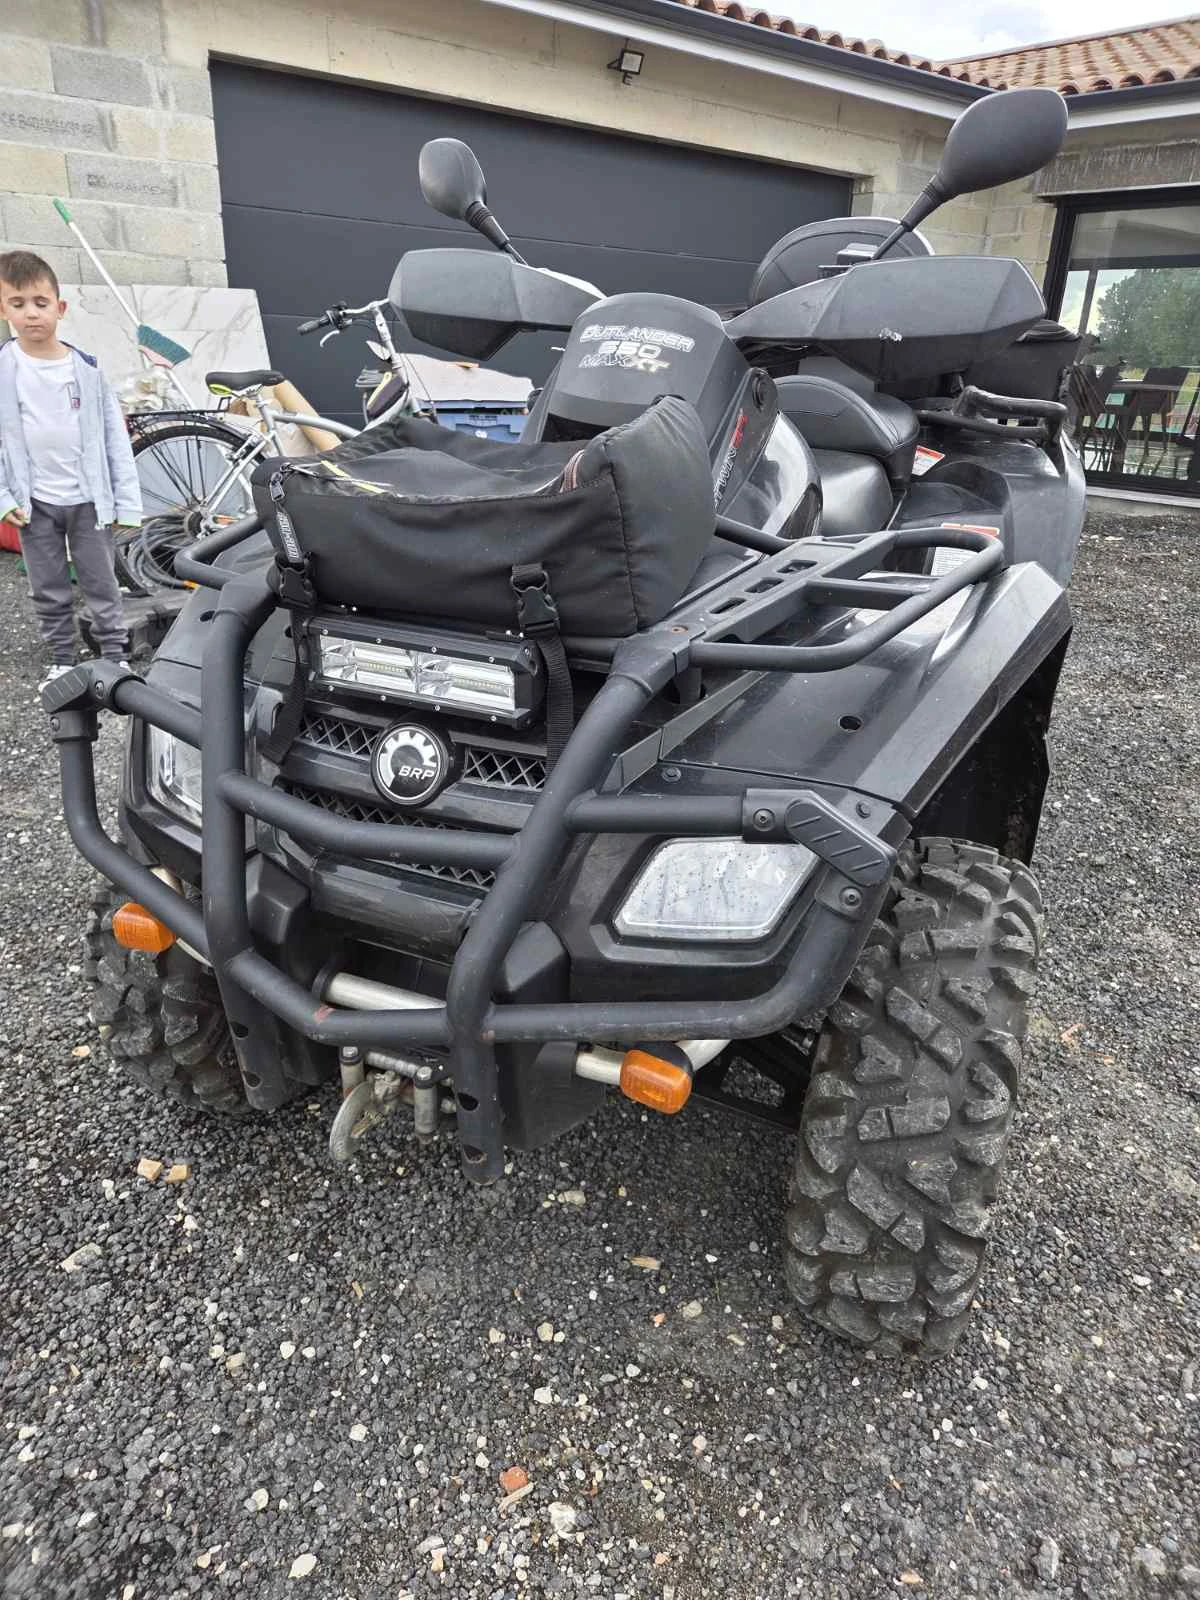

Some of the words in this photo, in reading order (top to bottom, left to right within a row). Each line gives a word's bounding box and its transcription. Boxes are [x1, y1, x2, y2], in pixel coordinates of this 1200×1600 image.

[579, 324, 696, 353] OUTLANDER
[598, 341, 662, 359] 650
[578, 353, 627, 368] MAX
[398, 765, 435, 780] BRP
